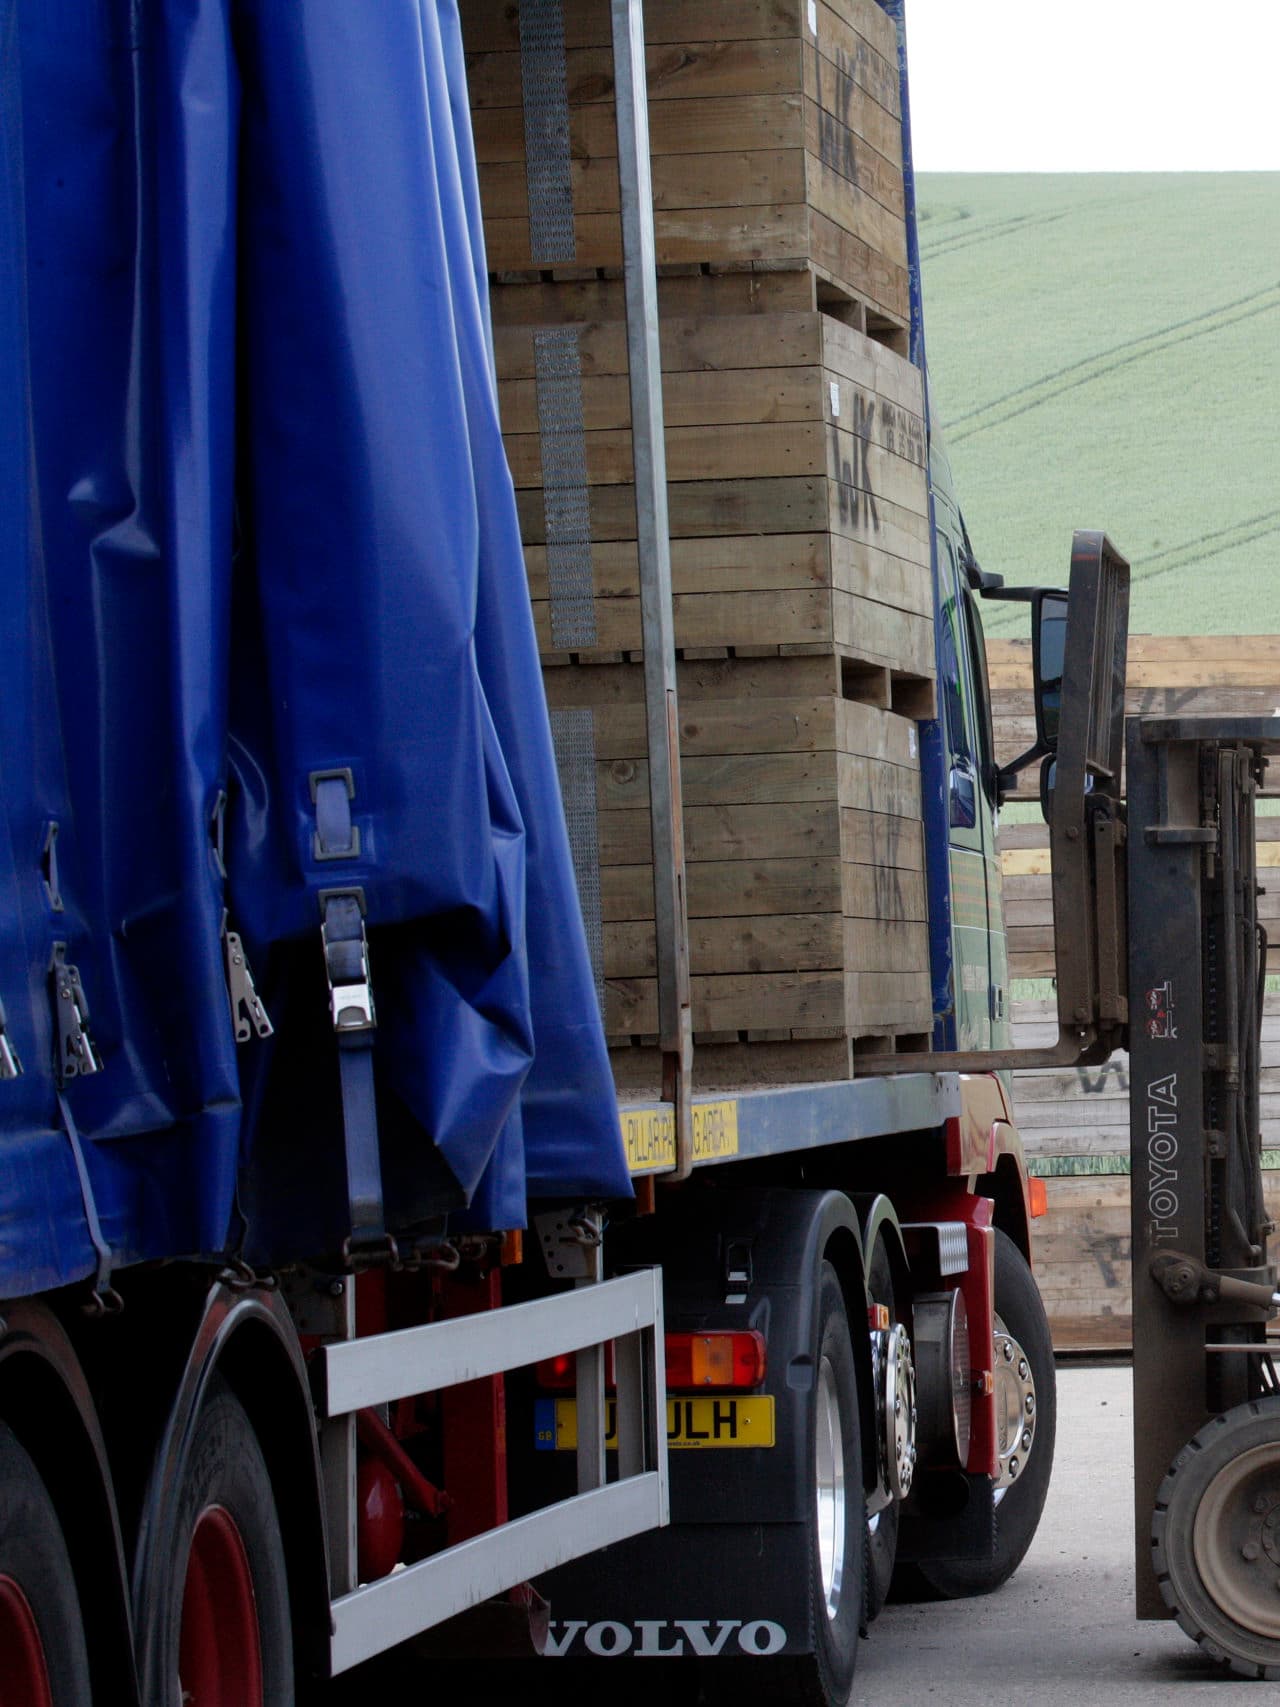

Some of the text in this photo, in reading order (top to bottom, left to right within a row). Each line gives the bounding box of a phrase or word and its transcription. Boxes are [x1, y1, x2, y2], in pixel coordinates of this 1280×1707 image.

[1147, 1073, 1179, 1246] TOYOTA
[538, 1431, 553, 1441] GB
[543, 1620, 787, 1656] VOLVO
